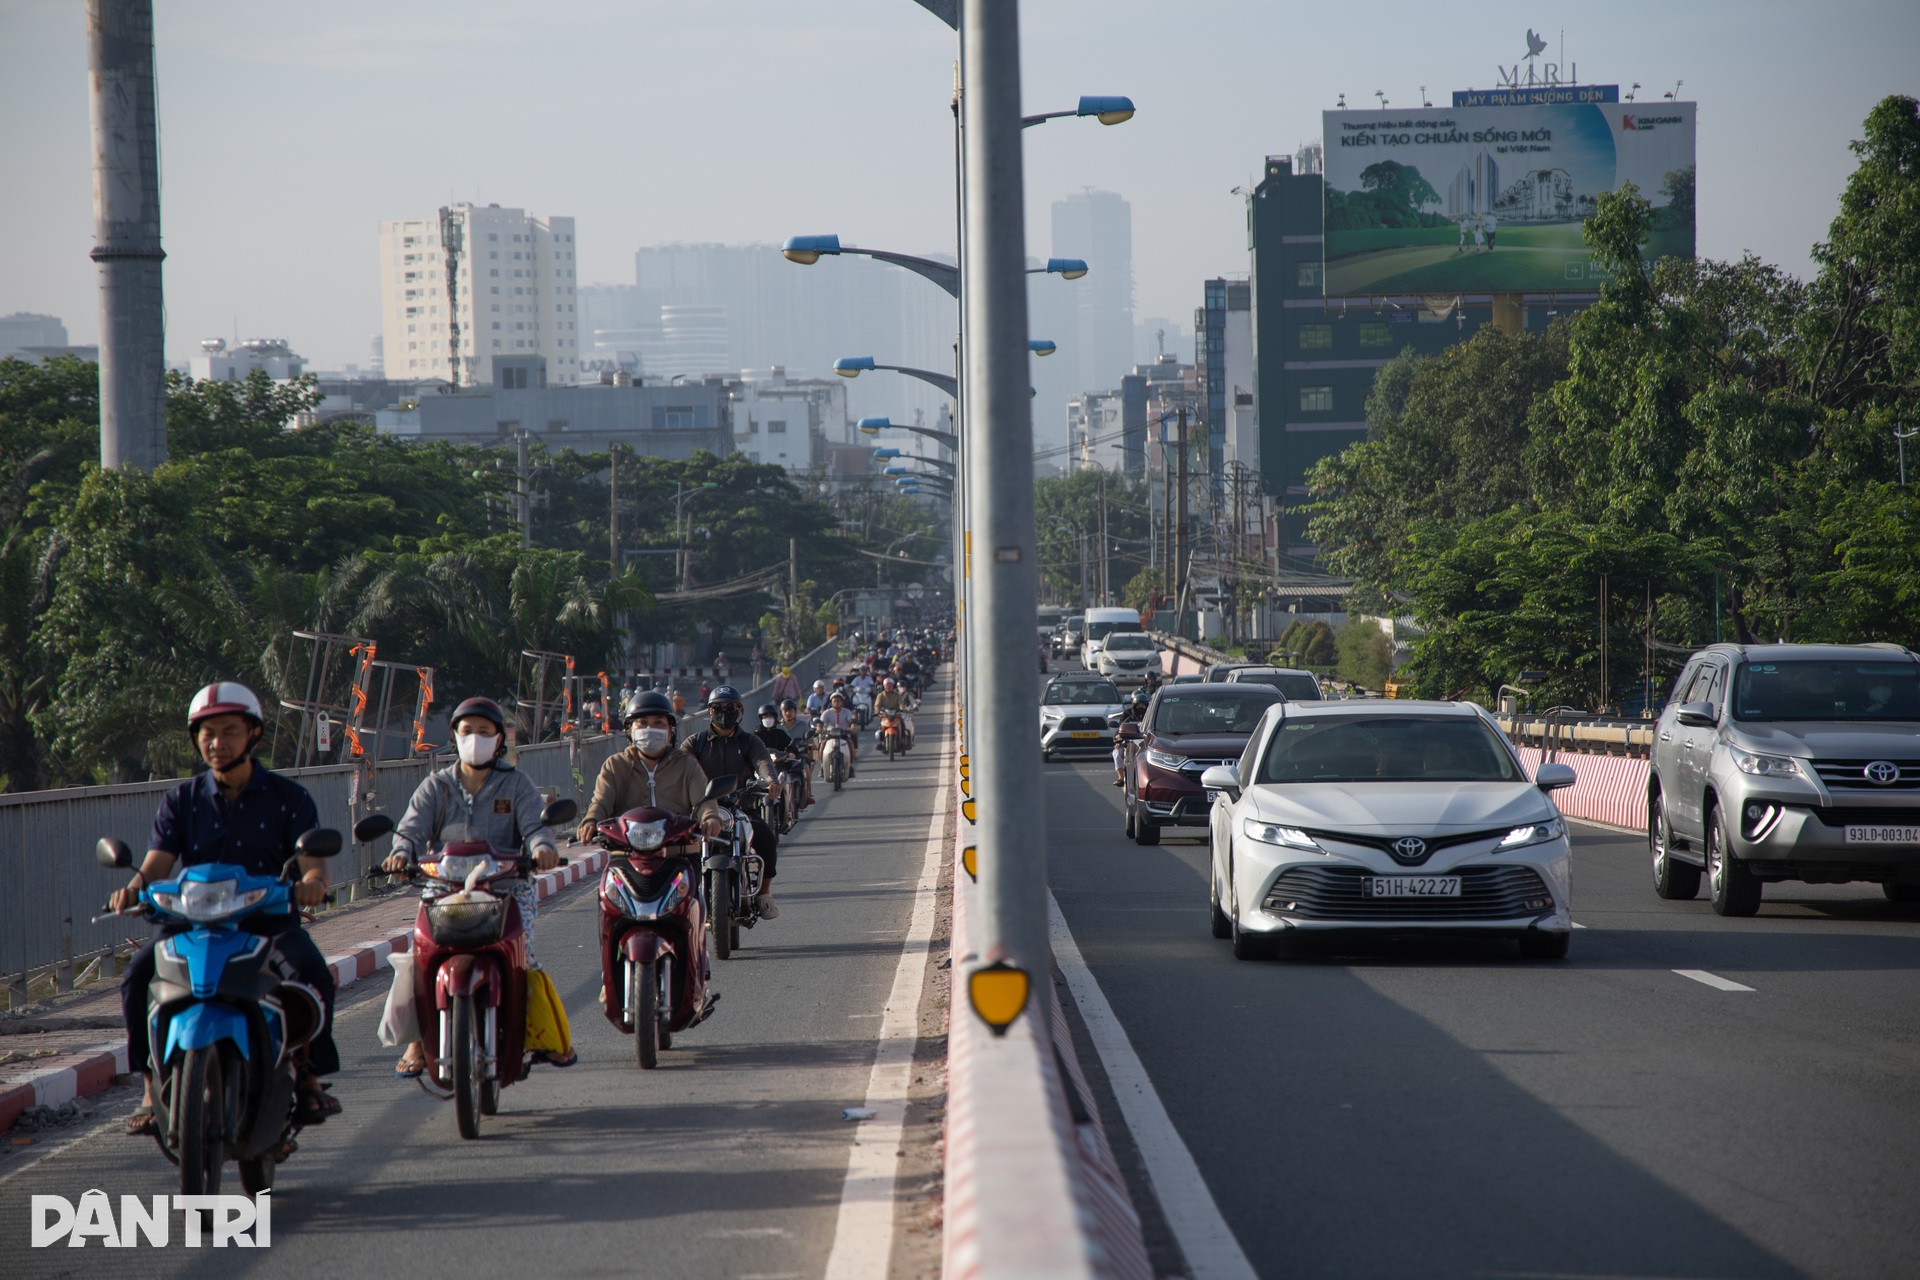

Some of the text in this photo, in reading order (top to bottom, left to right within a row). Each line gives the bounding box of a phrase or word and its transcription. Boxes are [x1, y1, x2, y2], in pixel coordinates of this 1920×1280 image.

[1378, 121, 1397, 129] hiệu
[1398, 119, 1413, 128] bất
[1415, 120, 1437, 129] động
[1439, 119, 1456, 127] sản
[1341, 126, 1551, 147] KIẾN TẠO CHUẨN SỐNG MỚI
[1496, 144, 1551, 154] tại Việt Nam
[580, 359, 615, 372] LAZA
[1850, 828, 1919, 842] 93LD-003.04
[1375, 879, 1458, 896] 51H-422.27
